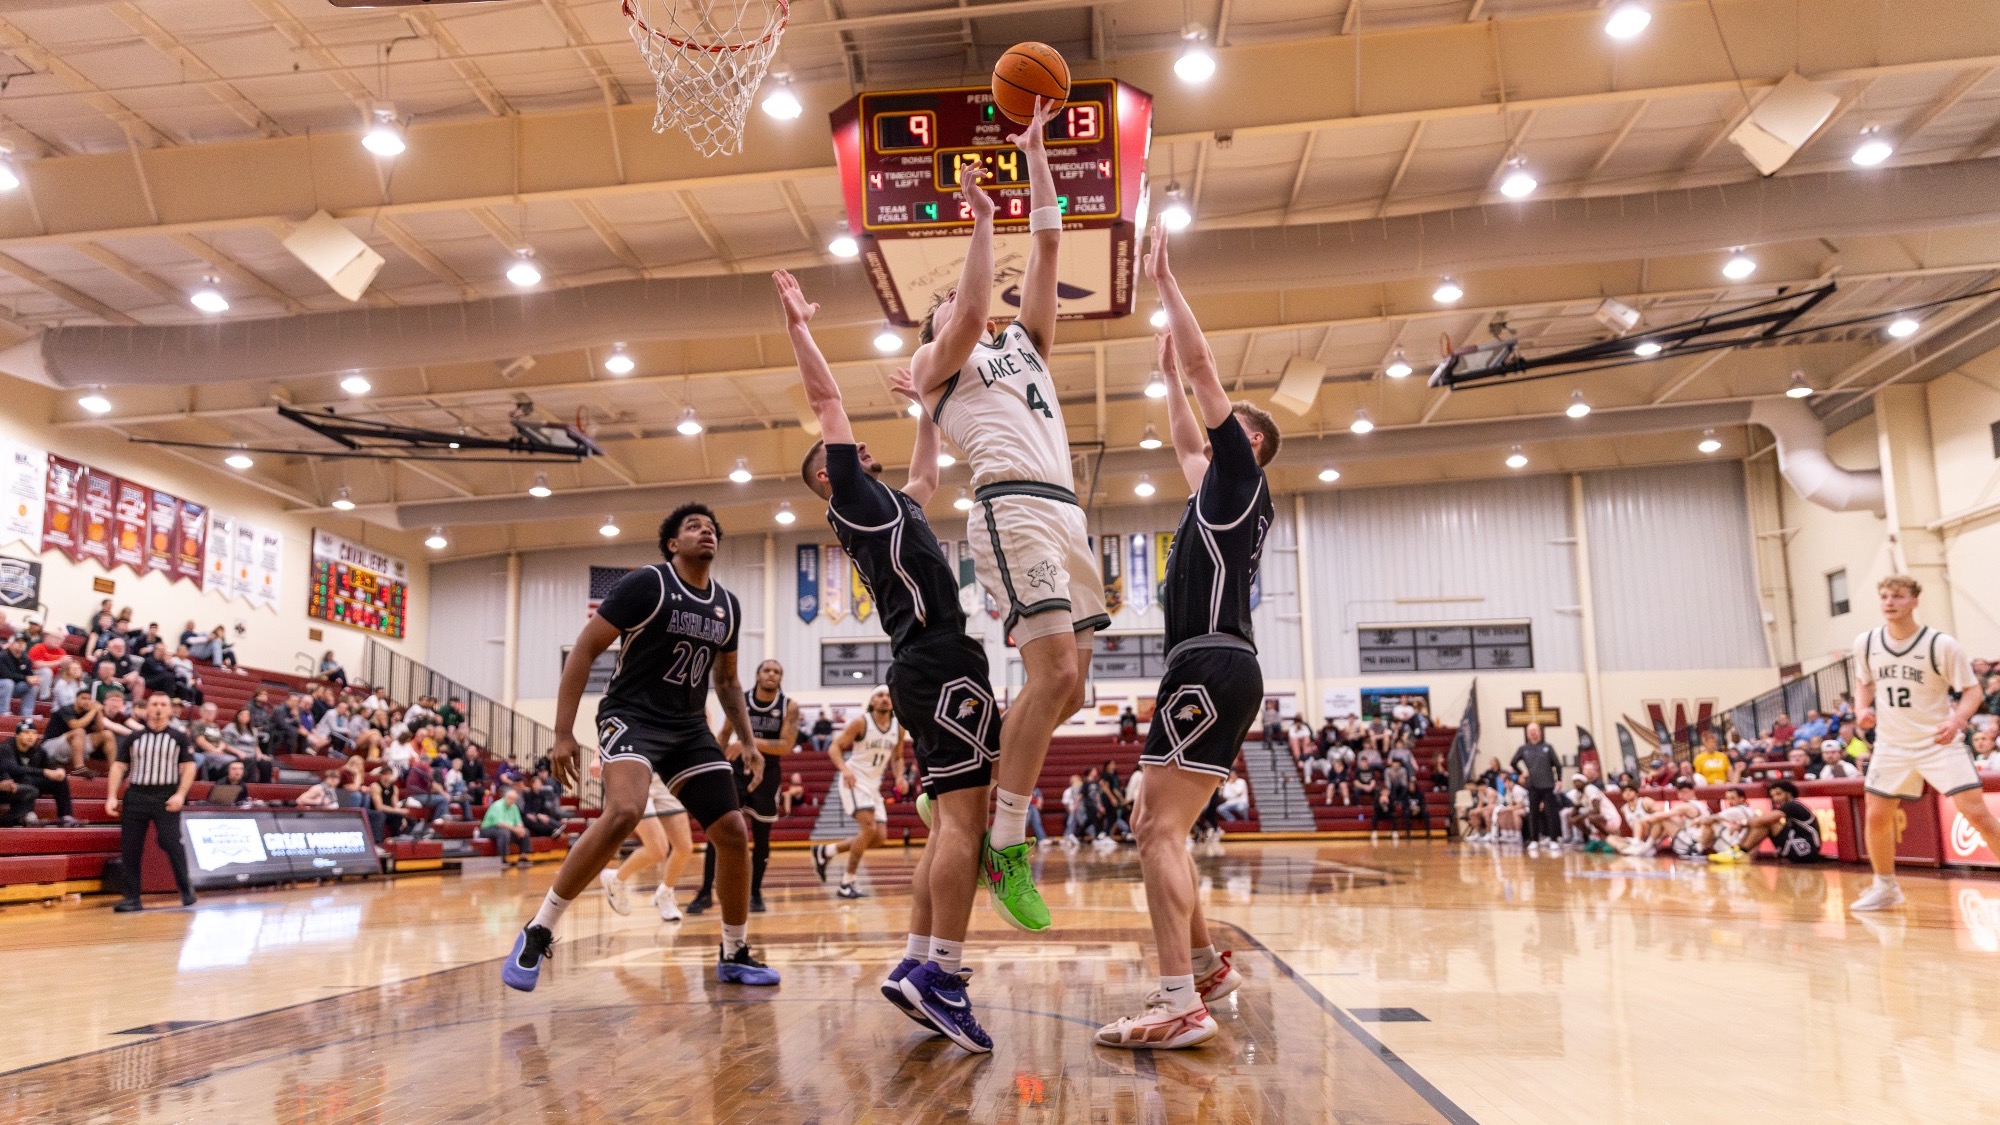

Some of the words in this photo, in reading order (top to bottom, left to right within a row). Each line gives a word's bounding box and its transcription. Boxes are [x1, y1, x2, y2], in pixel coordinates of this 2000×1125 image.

[1068, 106, 1095, 137] 13
[909, 115, 928, 146] 9
[901, 155, 933, 165] BONUS
[1049, 161, 1097, 171] TIMEOUTS
[1099, 160, 1110, 177] 4
[870, 172, 881, 189] 4
[884, 170, 932, 180] TIMEOUTS
[1060, 170, 1084, 179] LEFT
[895, 179, 919, 189] LEFT
[1000, 187, 1030, 198] FOULS
[1010, 198, 1022, 216] 0
[1074, 203, 1106, 213] FOULS
[1076, 195, 1105, 204] TEAM
[878, 205, 907, 214] TEAM
[878, 212, 909, 222] FOULS
[925, 203, 937, 220] 4
[977, 354, 1021, 388] LAKE
[1026, 383, 1053, 418] 4
[666, 609, 727, 645] ASHLAND
[663, 640, 711, 688] 20
[1902, 665, 1925, 685] ERIE
[1887, 687, 1912, 708] 12
